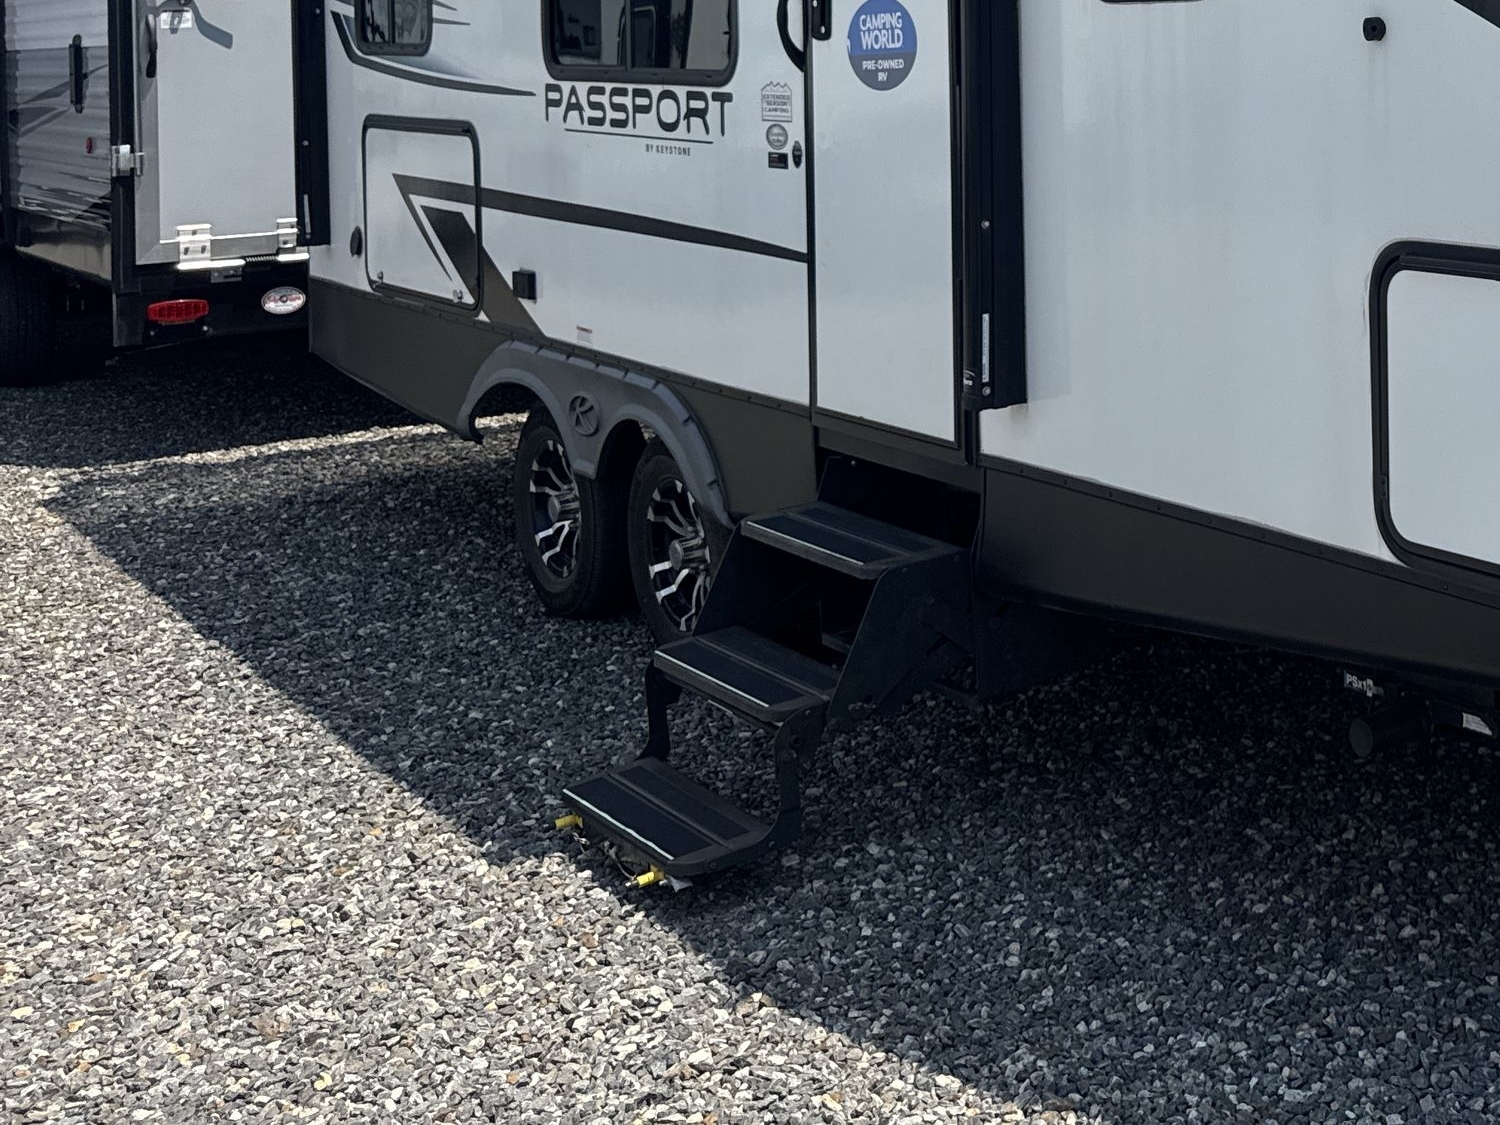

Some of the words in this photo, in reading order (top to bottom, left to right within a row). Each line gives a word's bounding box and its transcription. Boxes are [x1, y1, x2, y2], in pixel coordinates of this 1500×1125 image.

[859, 11, 903, 30] CAMPING
[860, 29, 903, 50] WORLD
[862, 58, 905, 70] PRE-OWNED
[877, 71, 888, 82] RV
[545, 83, 734, 137] PASSPORT
[645, 143, 654, 153] BY
[655, 145, 692, 157] KEYSTONE
